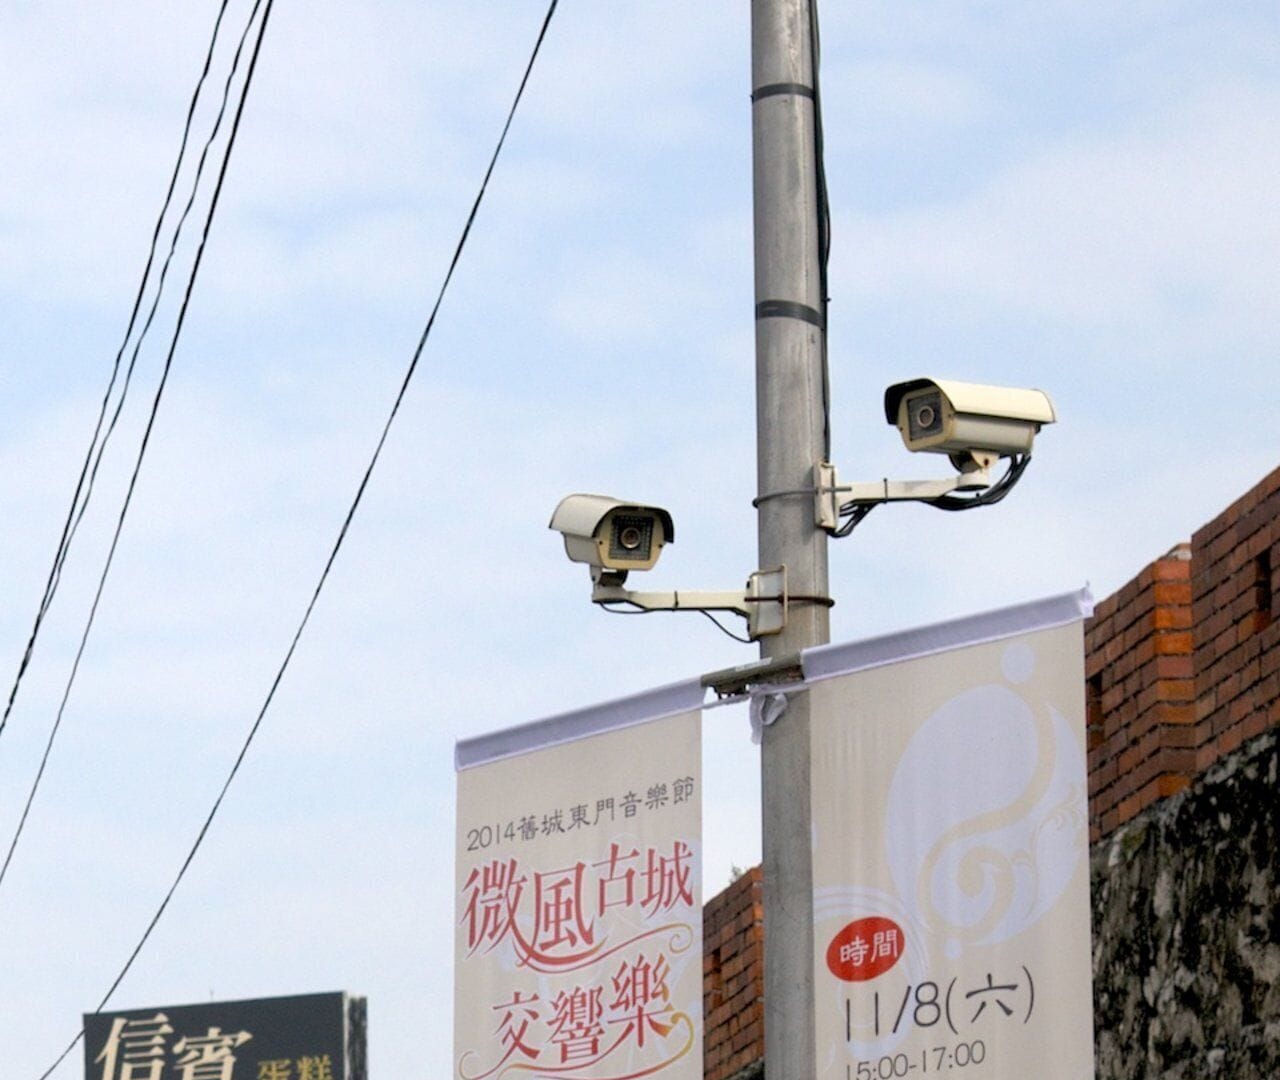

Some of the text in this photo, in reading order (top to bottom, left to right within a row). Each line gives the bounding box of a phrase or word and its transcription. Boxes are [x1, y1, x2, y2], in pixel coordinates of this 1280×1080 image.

[466, 776, 695, 851] 2014舊城東門音樂節
[460, 840, 694, 966] 微風古城
[840, 928, 898, 966] 時間
[490, 953, 676, 1066] 交響樂
